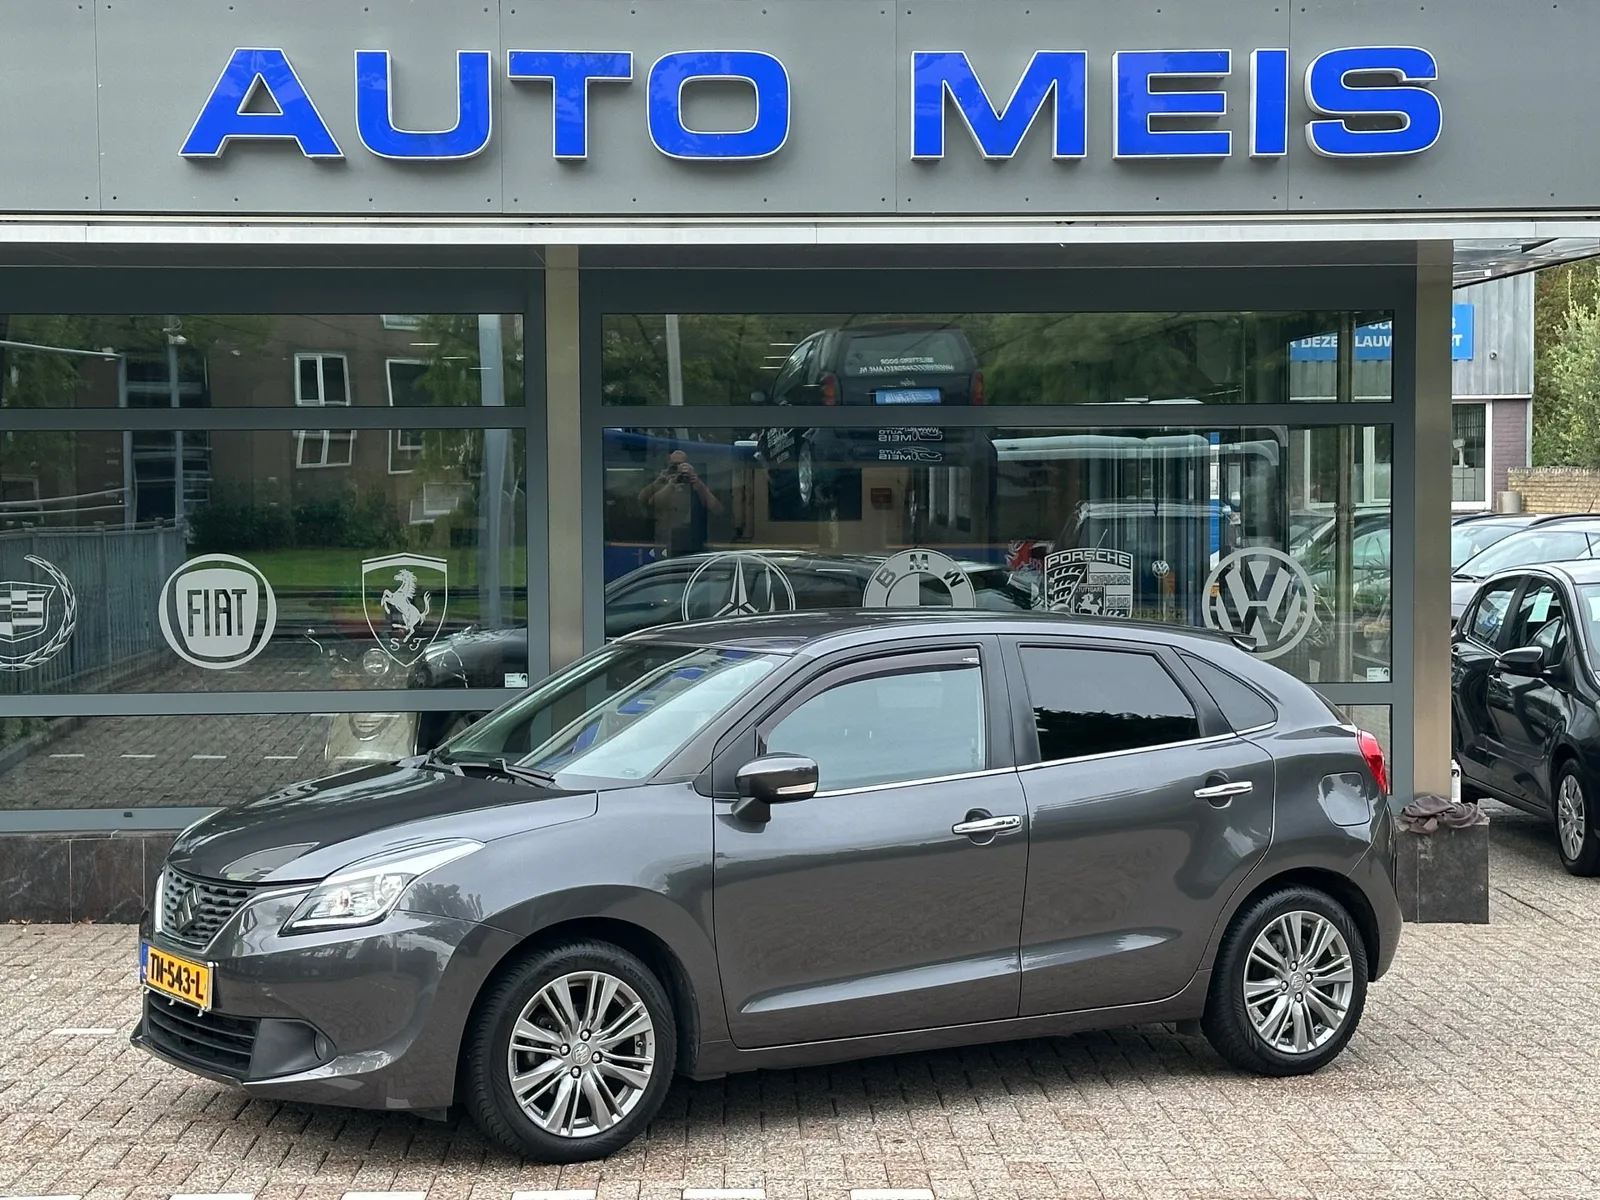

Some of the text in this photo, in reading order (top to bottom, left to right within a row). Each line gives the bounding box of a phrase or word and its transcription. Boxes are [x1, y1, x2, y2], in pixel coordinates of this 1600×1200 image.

[177, 45, 1443, 161] AUTO MEIS
[875, 553, 965, 588] BMW
[1047, 551, 1131, 568] PORSCHE
[187, 588, 247, 637] FIAT
[150, 952, 204, 1000] TN-543-L
